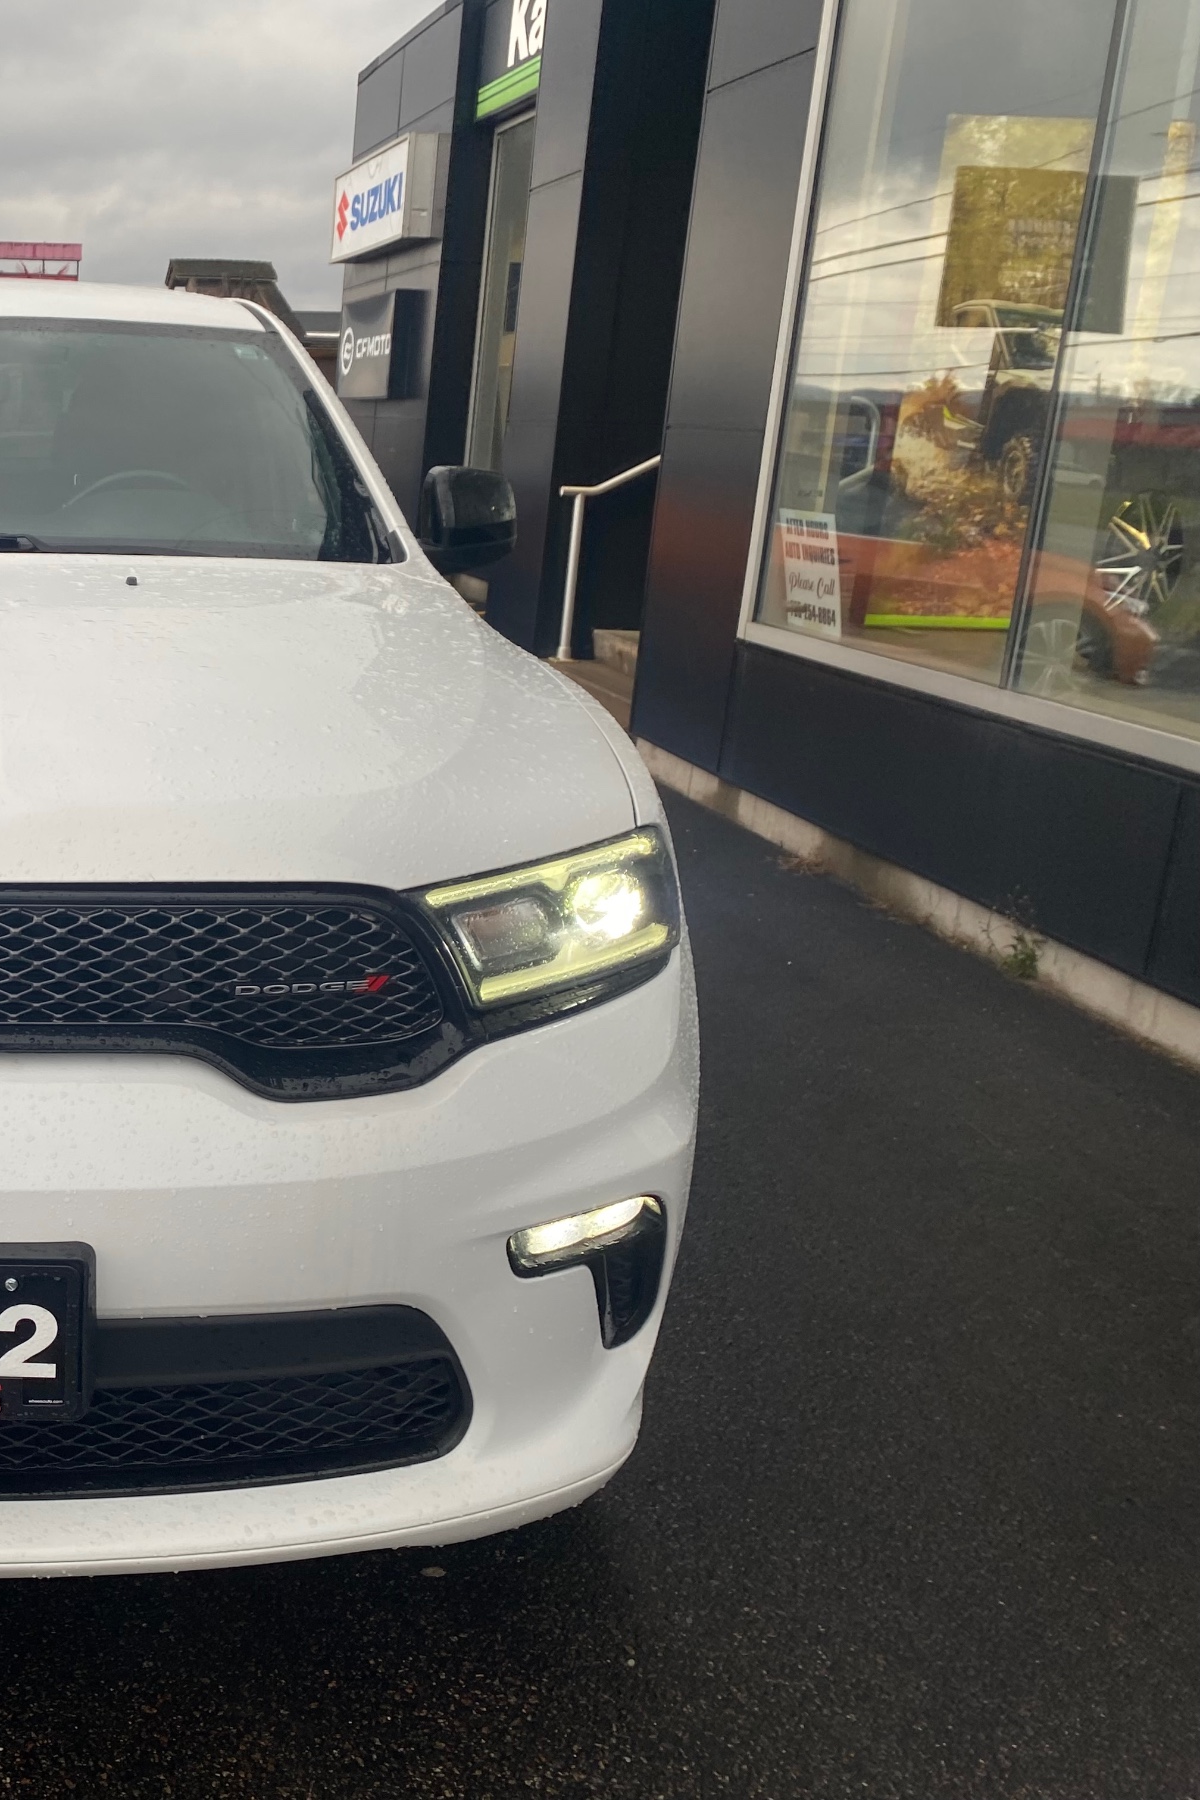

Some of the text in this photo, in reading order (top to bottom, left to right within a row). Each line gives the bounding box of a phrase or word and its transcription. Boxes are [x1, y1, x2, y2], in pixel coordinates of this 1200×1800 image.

[350, 172, 403, 231] SUZUKI
[356, 333, 391, 358] CFMOTO
[786, 518, 829, 540] AFTER HOURS
[785, 541, 836, 566] AUTO INQUIRIES
[788, 571, 835, 599] Please Call
[234, 979, 370, 996] DODGE
